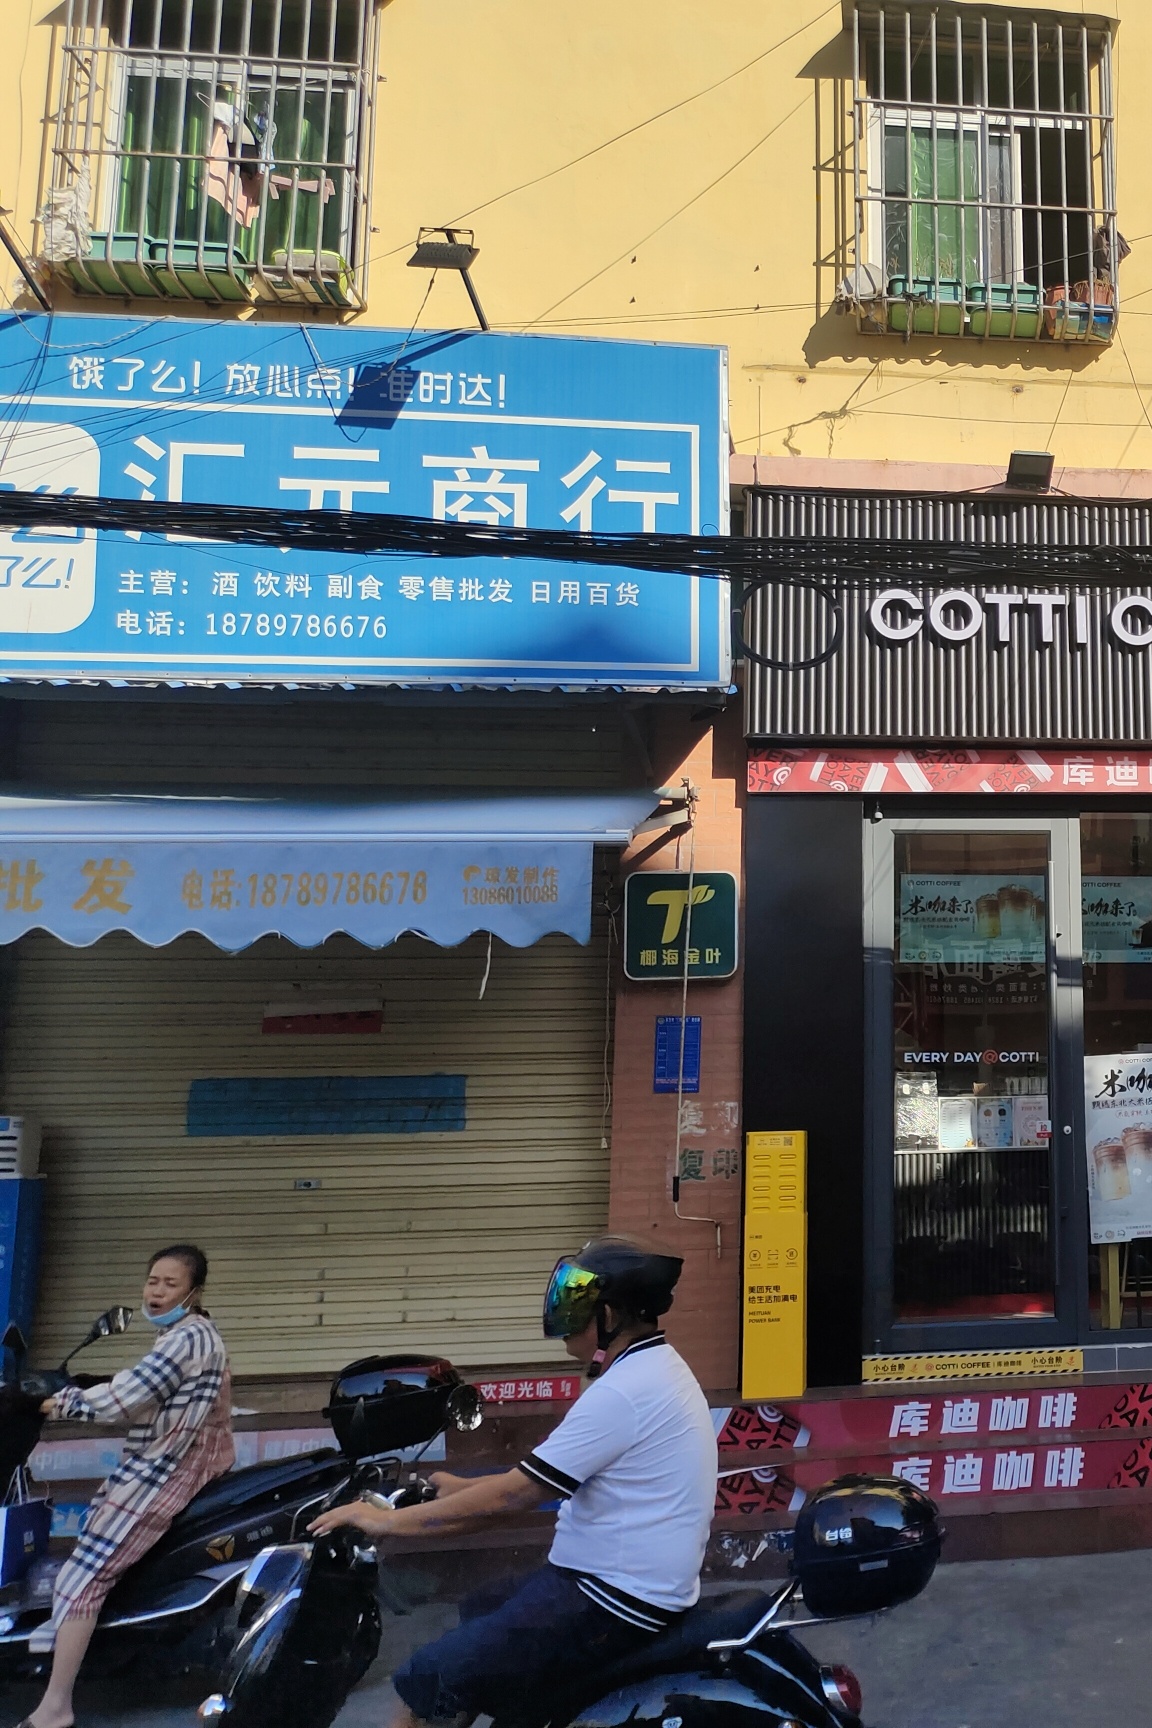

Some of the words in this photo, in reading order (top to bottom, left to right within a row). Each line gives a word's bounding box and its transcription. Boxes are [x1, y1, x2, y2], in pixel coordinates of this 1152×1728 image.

[213, 572, 239, 597] 酒
[254, 573, 313, 599] 饮料
[328, 574, 384, 602] 副食
[398, 575, 513, 602] 零售批发
[531, 580, 640, 607] 日用百货
[206, 612, 387, 638] 18789786676
[869, 589, 1087, 645] COTTI
[640, 948, 722, 966] 椰海金叶
[904, 1052, 949, 1063] EVERY
[873, 1363, 906, 1372] 小心台阶
[935, 1363, 958, 1371] COTTI
[961, 1361, 991, 1369] COFFEE
[1031, 1356, 1063, 1365] 小心台阶
[480, 1381, 553, 1400] 欢迎光临
[888, 1391, 1078, 1439] 库迪咖啡
[891, 1446, 1086, 1495] 库迪咖啡
